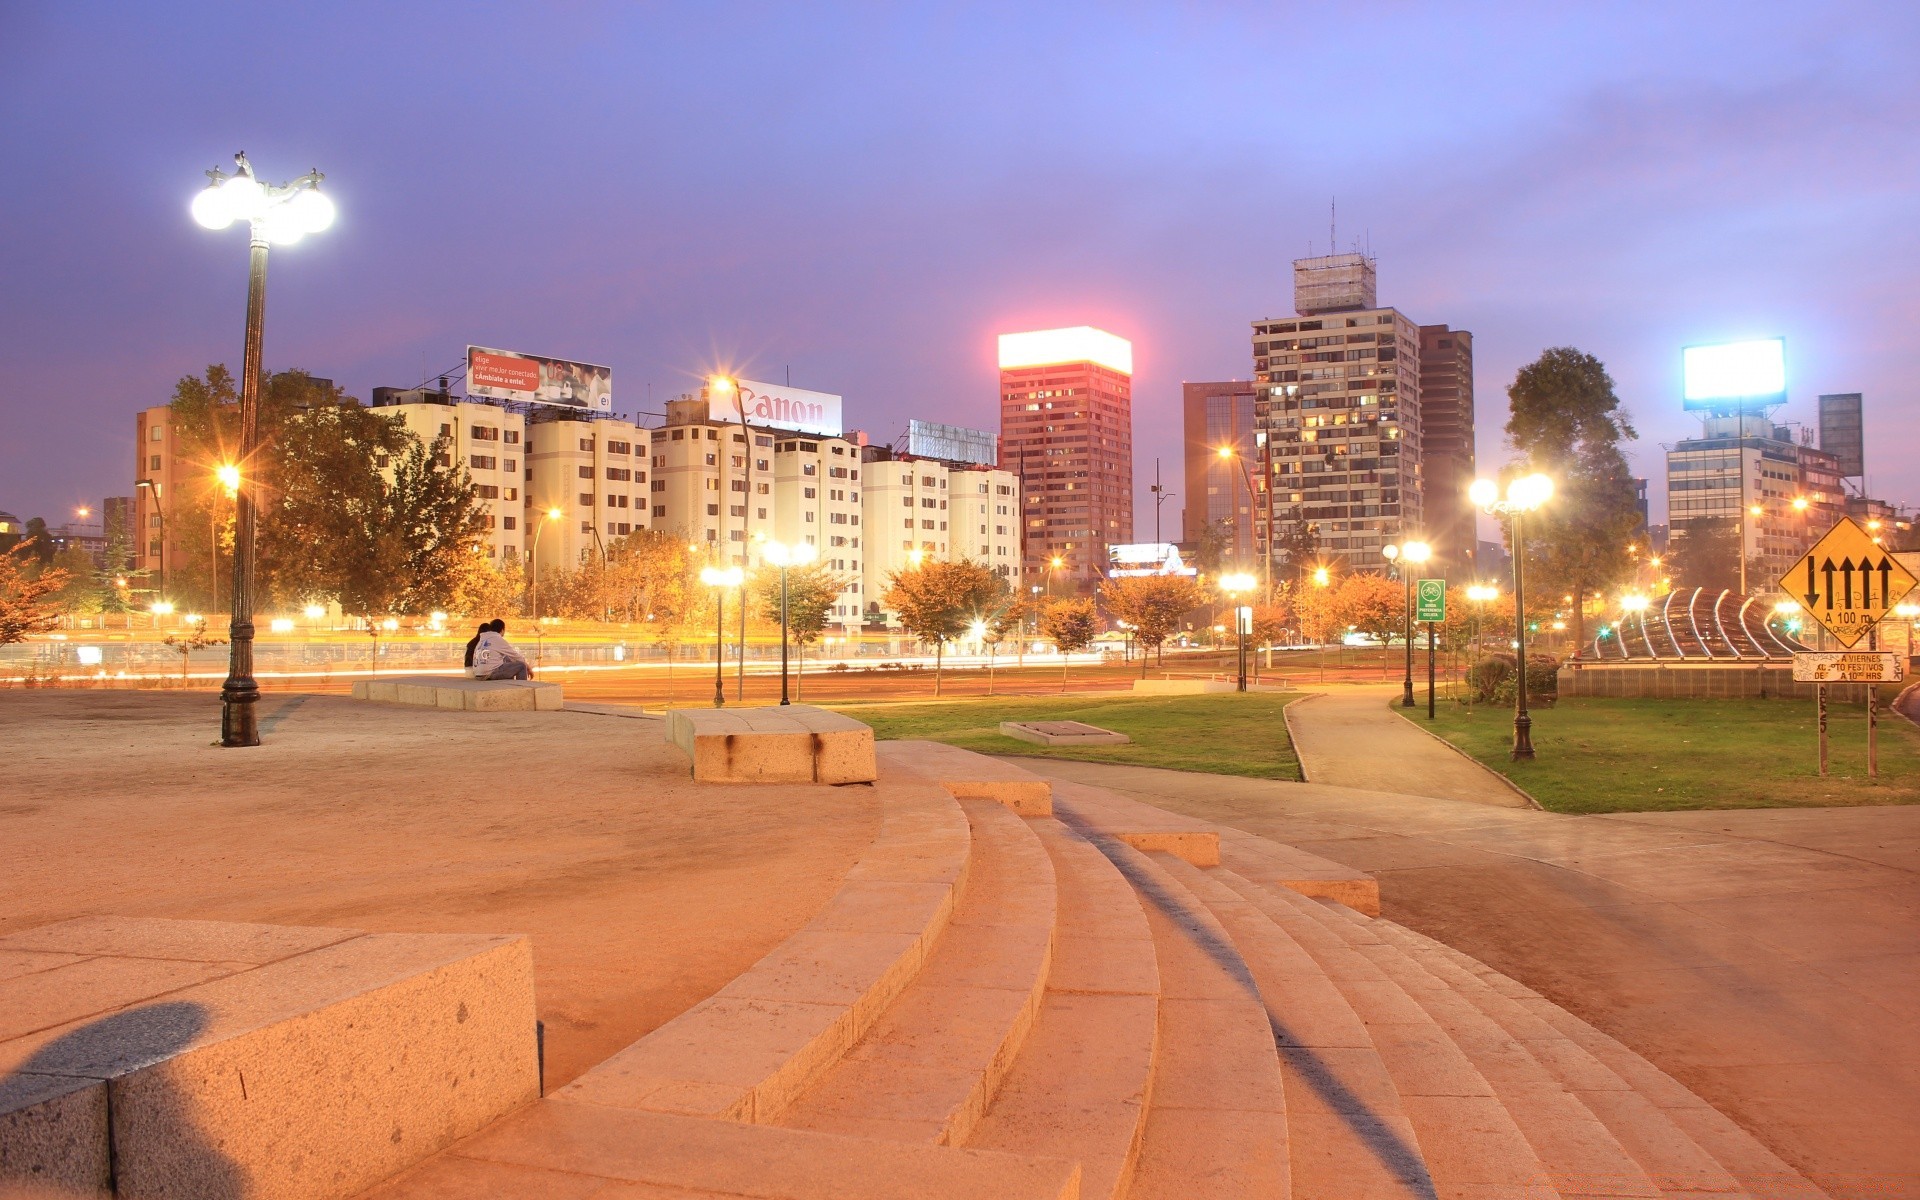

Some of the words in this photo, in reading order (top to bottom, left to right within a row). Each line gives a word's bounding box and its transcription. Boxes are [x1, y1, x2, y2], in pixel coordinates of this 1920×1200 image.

[475, 356, 489, 364] elige
[475, 364, 487, 372] vivir
[732, 387, 824, 424] Canon
[1825, 612, 1833, 624] A
[1838, 611, 1856, 624] 100
[1841, 672, 1847, 680] A
[1866, 672, 1882, 680] HRS
